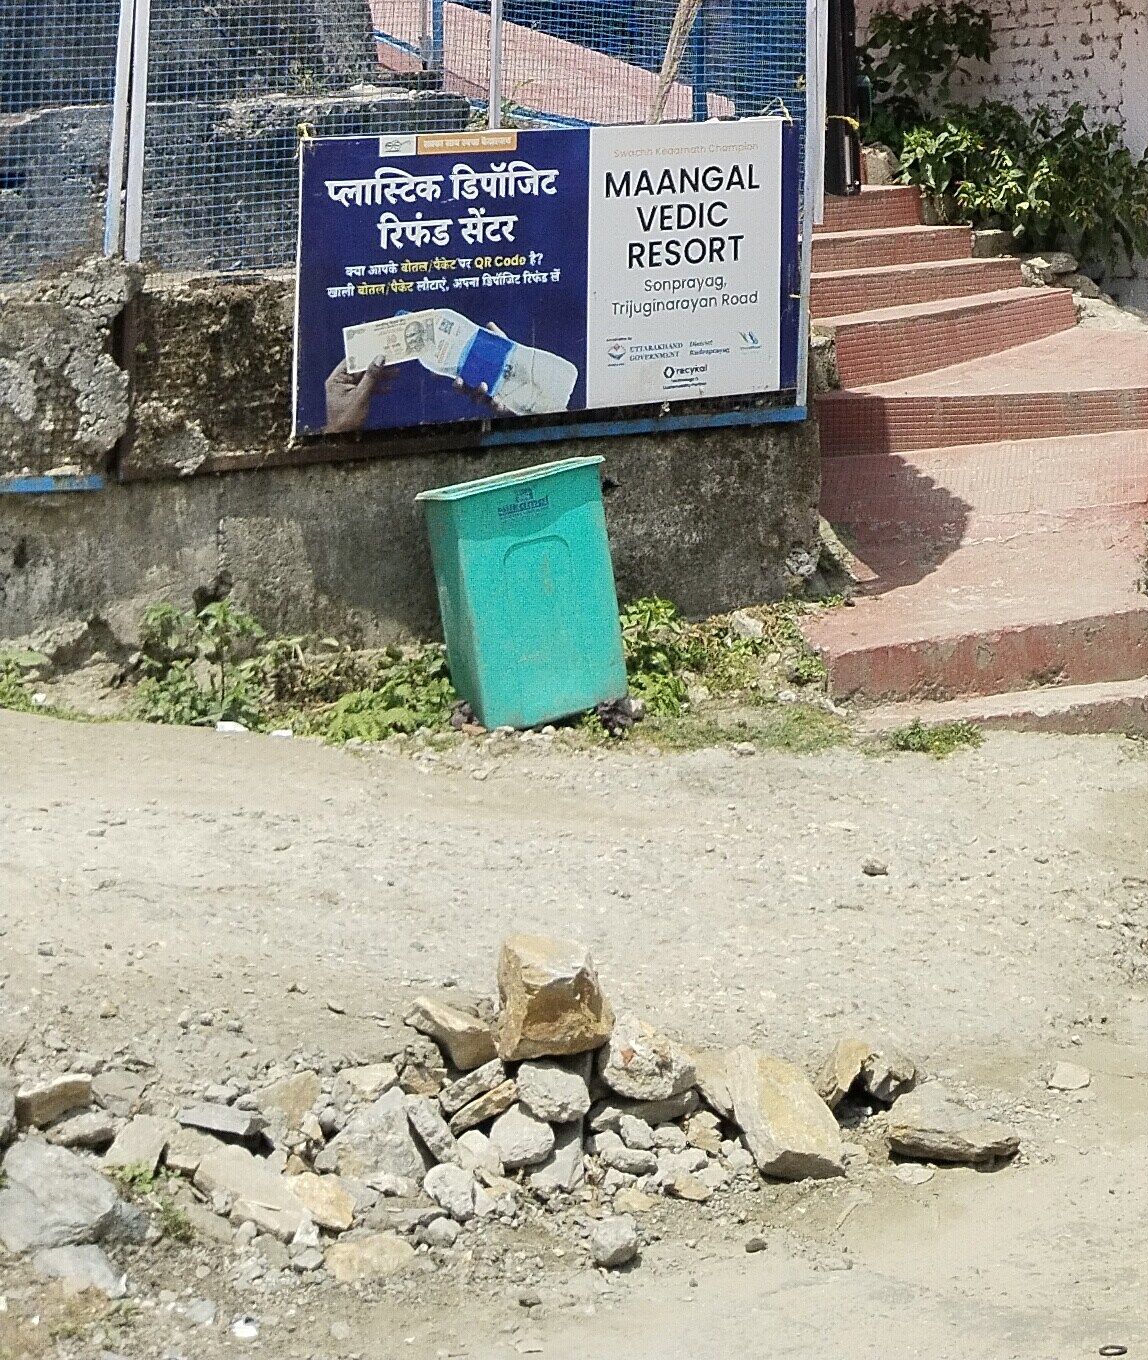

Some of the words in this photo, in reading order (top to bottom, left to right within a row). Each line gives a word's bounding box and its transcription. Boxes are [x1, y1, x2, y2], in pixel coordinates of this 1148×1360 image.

[325, 166, 444, 207] प्लास्टिक
[450, 160, 559, 200] डिपॉजिट
[605, 164, 760, 198] MAANGAL
[377, 211, 453, 249] रिफंड
[458, 208, 518, 244] सेंटर
[636, 201, 729, 232] VEDIC
[345, 266, 366, 277] क्या
[368, 261, 398, 276] आपके
[457, 258, 473, 269] पर
[474, 256, 493, 270] QR
[494, 254, 527, 267] Code
[529, 250, 544, 267] है?
[628, 234, 745, 269] RESORT
[326, 282, 355, 298] खाली
[453, 277, 480, 289] अपना
[482, 271, 521, 287] डिपॉजिट
[523, 269, 549, 284] रिफंड
[644, 275, 727, 292] Sonprayag,
[612, 296, 718, 318] Trijuginarayan
[722, 291, 758, 306] Road
